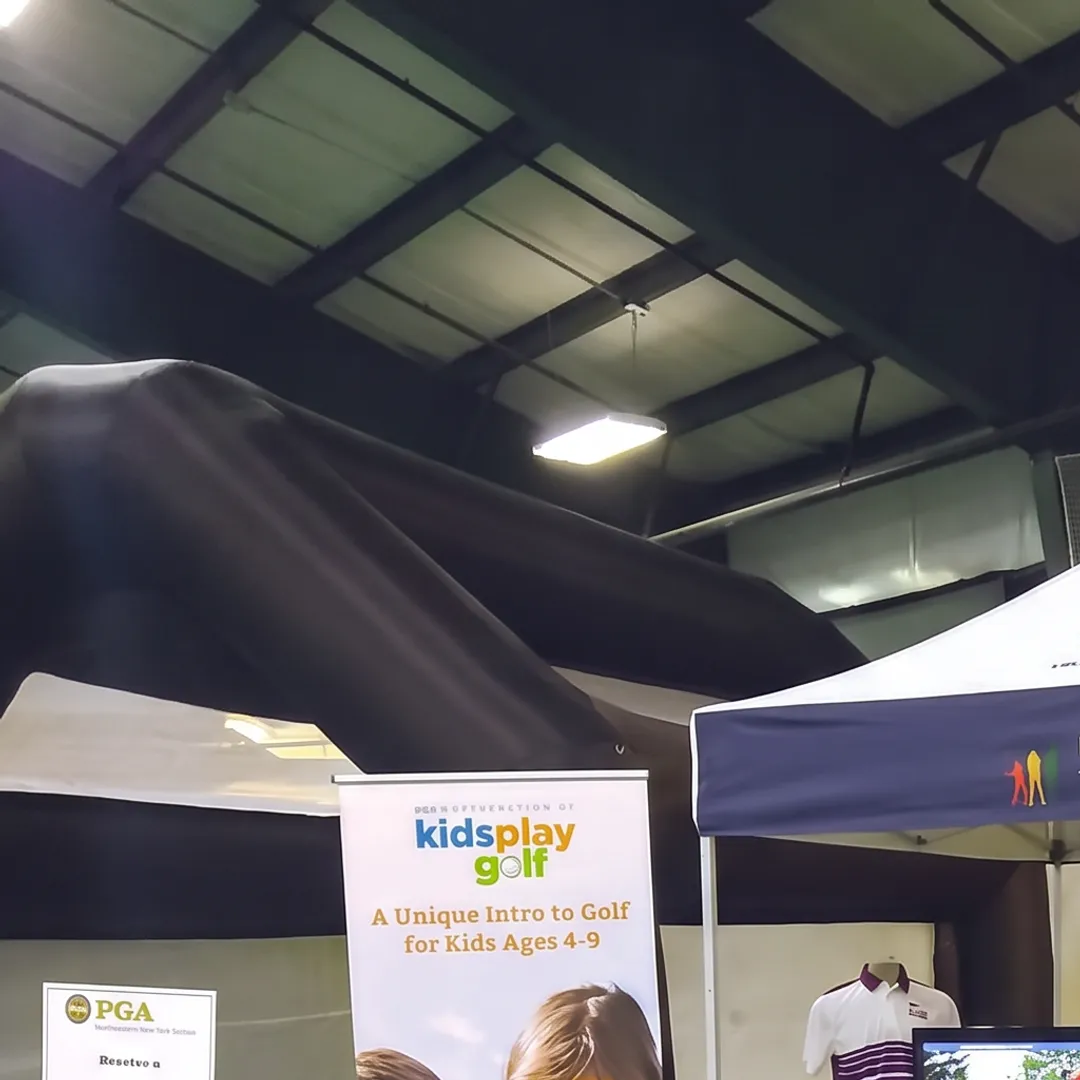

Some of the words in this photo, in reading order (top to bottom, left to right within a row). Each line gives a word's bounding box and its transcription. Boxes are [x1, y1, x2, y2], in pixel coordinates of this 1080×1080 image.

[415, 817, 576, 853] kidsplay
[474, 848, 548, 886] golf
[371, 908, 388, 926] A
[394, 906, 479, 929] Unique
[486, 904, 545, 923] Intro
[551, 904, 574, 922] to
[580, 901, 631, 921] Golf
[404, 935, 439, 953] for
[445, 933, 497, 952] Kids
[502, 933, 558, 956] Ages
[563, 931, 601, 949] 4-9
[95, 1000, 155, 1022] PGA
